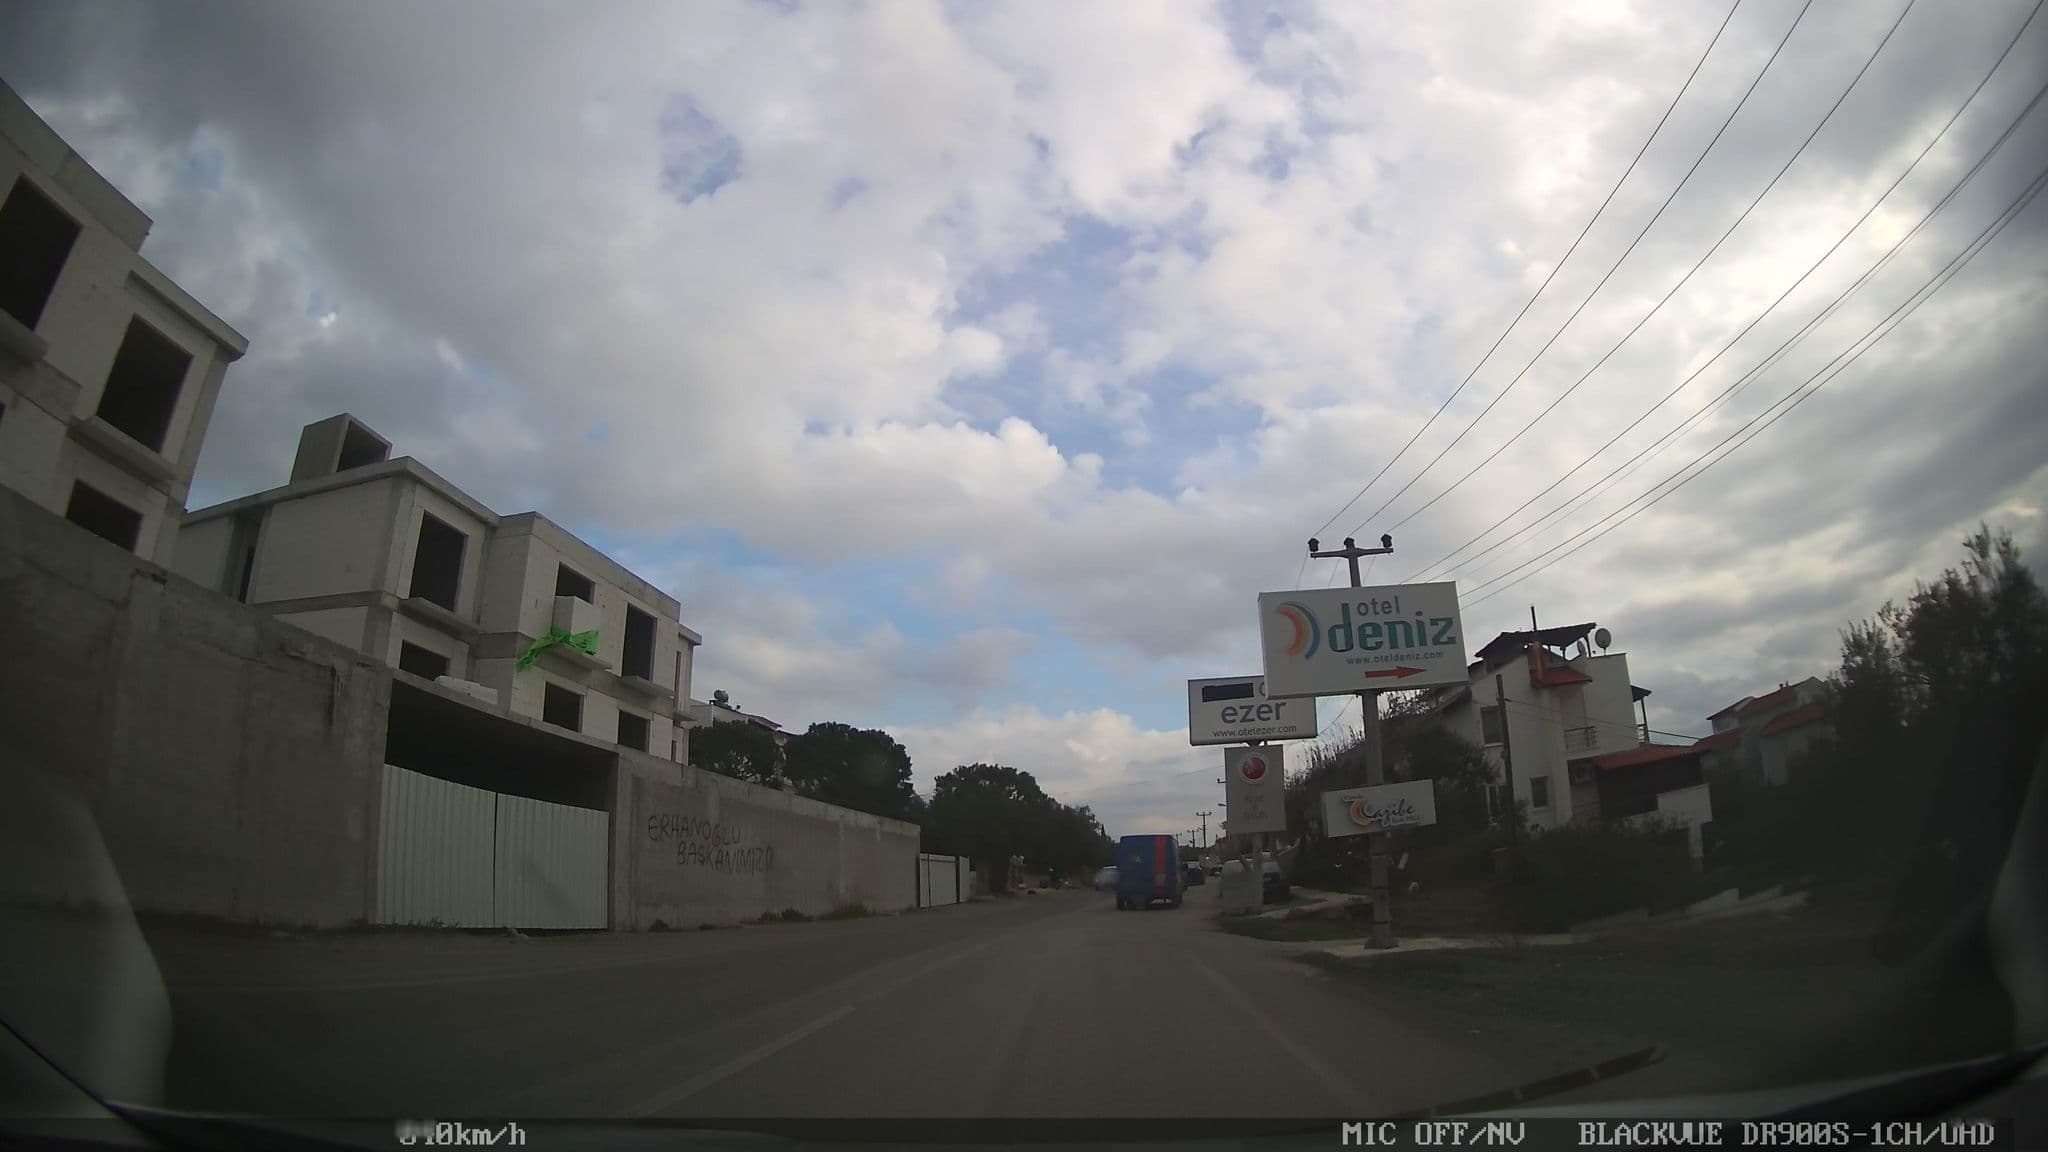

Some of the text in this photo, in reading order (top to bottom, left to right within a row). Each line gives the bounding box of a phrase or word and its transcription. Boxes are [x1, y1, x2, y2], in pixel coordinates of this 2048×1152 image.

[1357, 596, 1400, 617] otel
[1328, 602, 1457, 653] deniz
[1346, 651, 1444, 665] www.oteldeniz.com
[1221, 701, 1287, 724] ezer
[1213, 724, 1297, 738] www.otelezer.com
